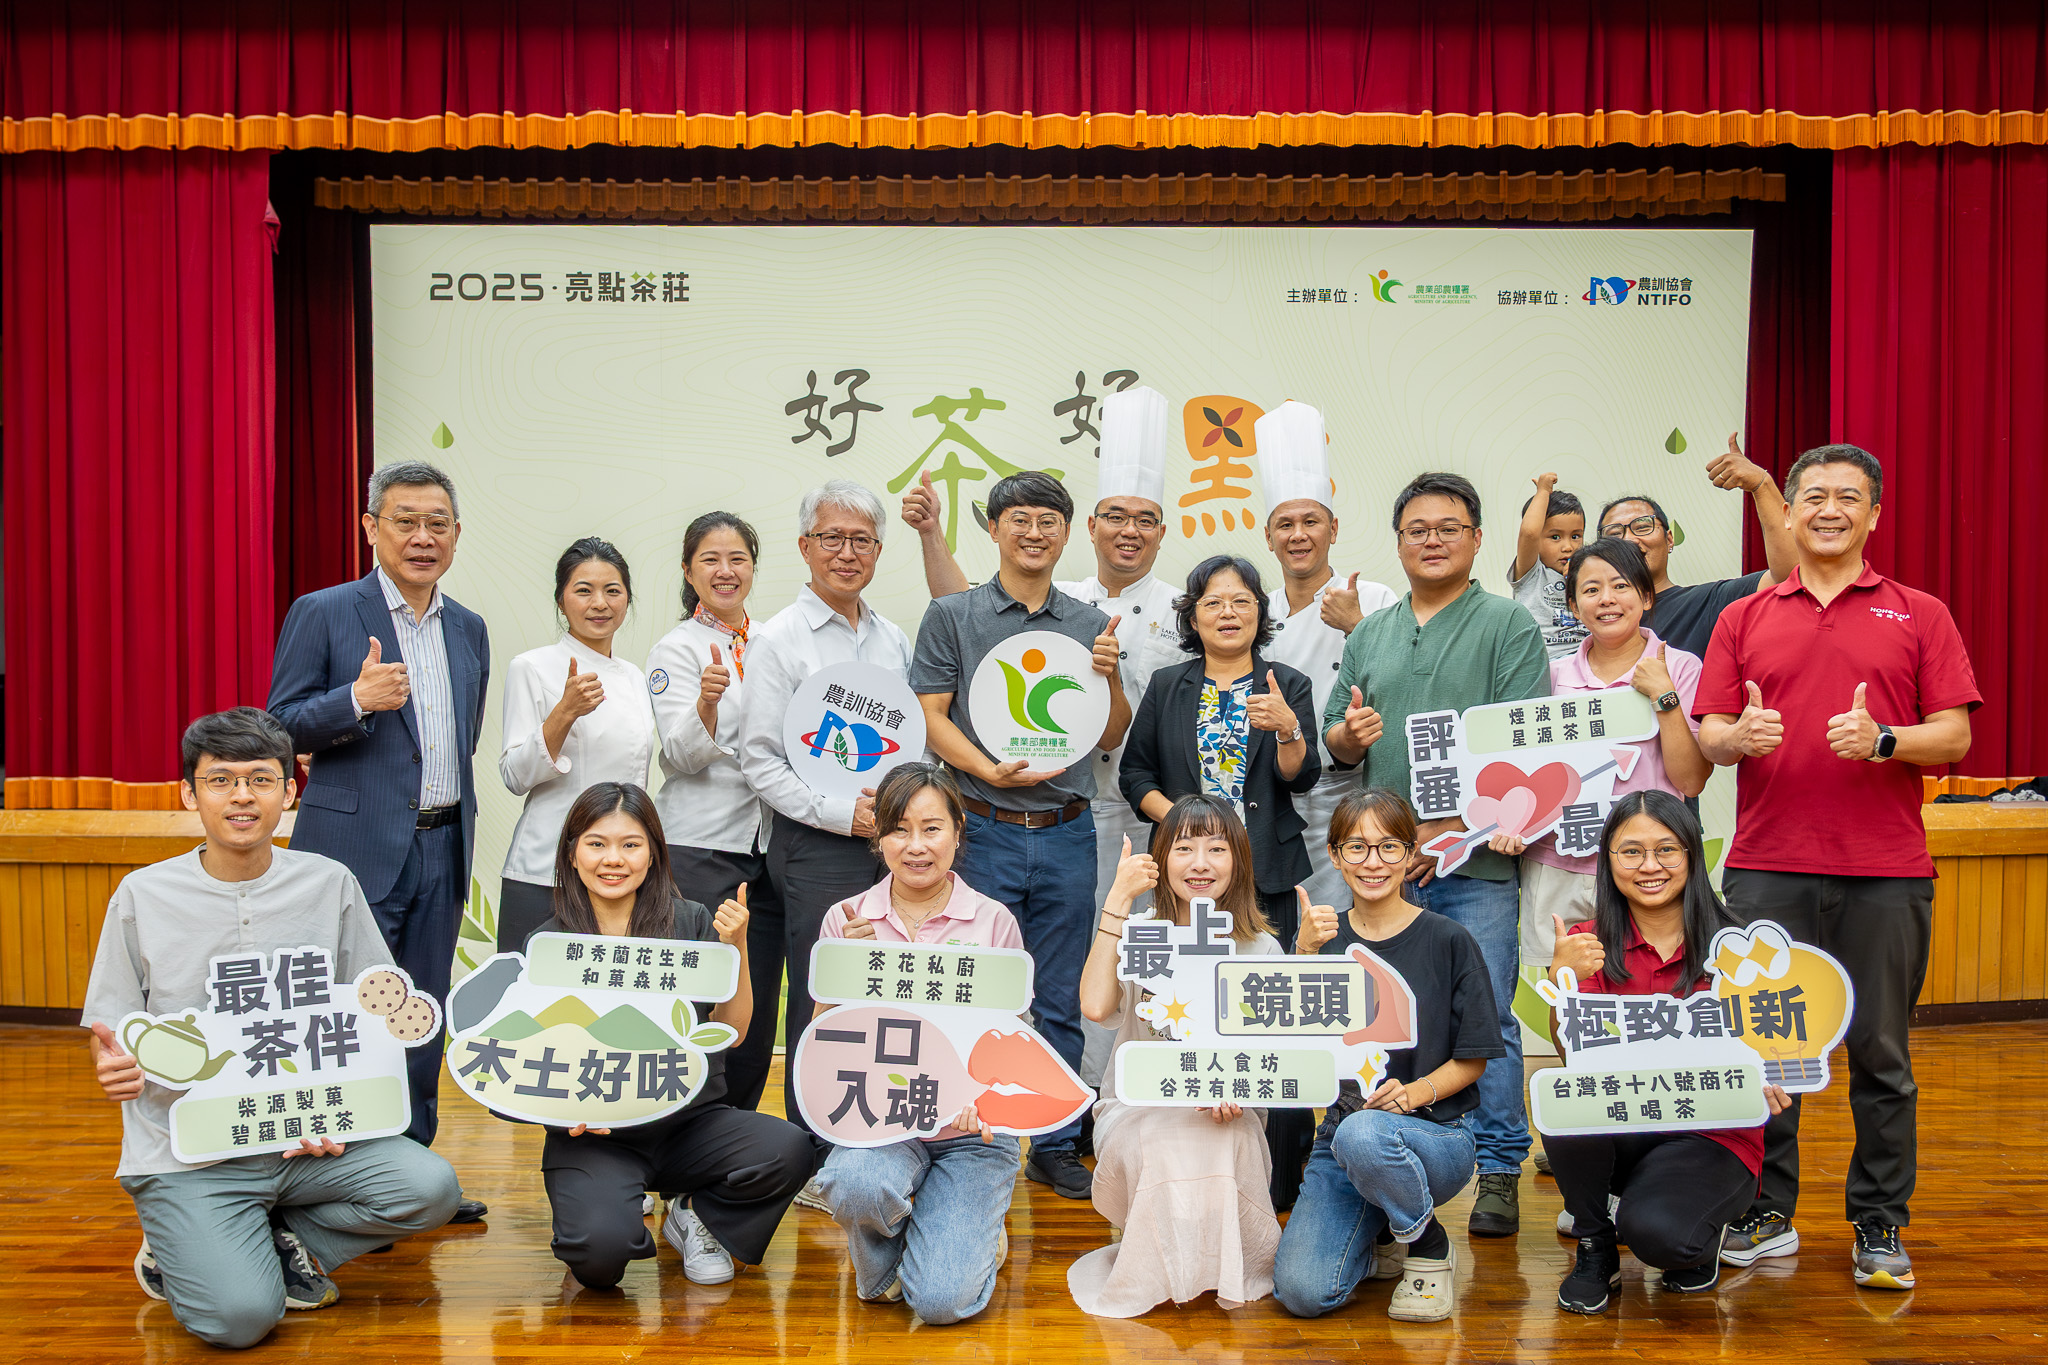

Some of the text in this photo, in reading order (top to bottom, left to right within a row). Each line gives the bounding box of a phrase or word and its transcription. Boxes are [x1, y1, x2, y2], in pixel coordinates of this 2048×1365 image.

[1637, 277, 1693, 292] 農訓協會
[1637, 294, 1692, 306] NTIFO
[1160, 633, 1178, 643] HOTEL
[822, 683, 906, 731] 農訓協會
[1508, 698, 1603, 726] 煙波飯店
[1010, 737, 1067, 747] 農業部農糧署
[1512, 719, 1605, 747] 星源茶園
[1410, 714, 1461, 814] 評審
[1559, 801, 1621, 852] 最
[566, 942, 700, 969] 鄭秀蘭花生糖
[1123, 904, 1230, 979] 最上
[868, 950, 975, 977] 茶花私廚
[212, 951, 331, 1016] 最佳
[581, 967, 677, 991] 和菓森林
[865, 977, 973, 1004] 天然茶莊
[1239, 972, 1352, 1028] 鏡頭
[1562, 984, 1807, 1052] 極致創新
[241, 1011, 361, 1079] 茶伴
[814, 1017, 922, 1066] 一口
[1180, 1051, 1279, 1073] 獵人食坊
[1160, 1077, 1298, 1099] 谷芳有機茶園
[1552, 1068, 1745, 1099] 台灣香十八號商行
[238, 1086, 343, 1118] 柴源製菓
[827, 1069, 939, 1131] 入魂
[1606, 1098, 1697, 1122] 喝喝茶
[231, 1110, 354, 1145] 碧羅園茗茶
